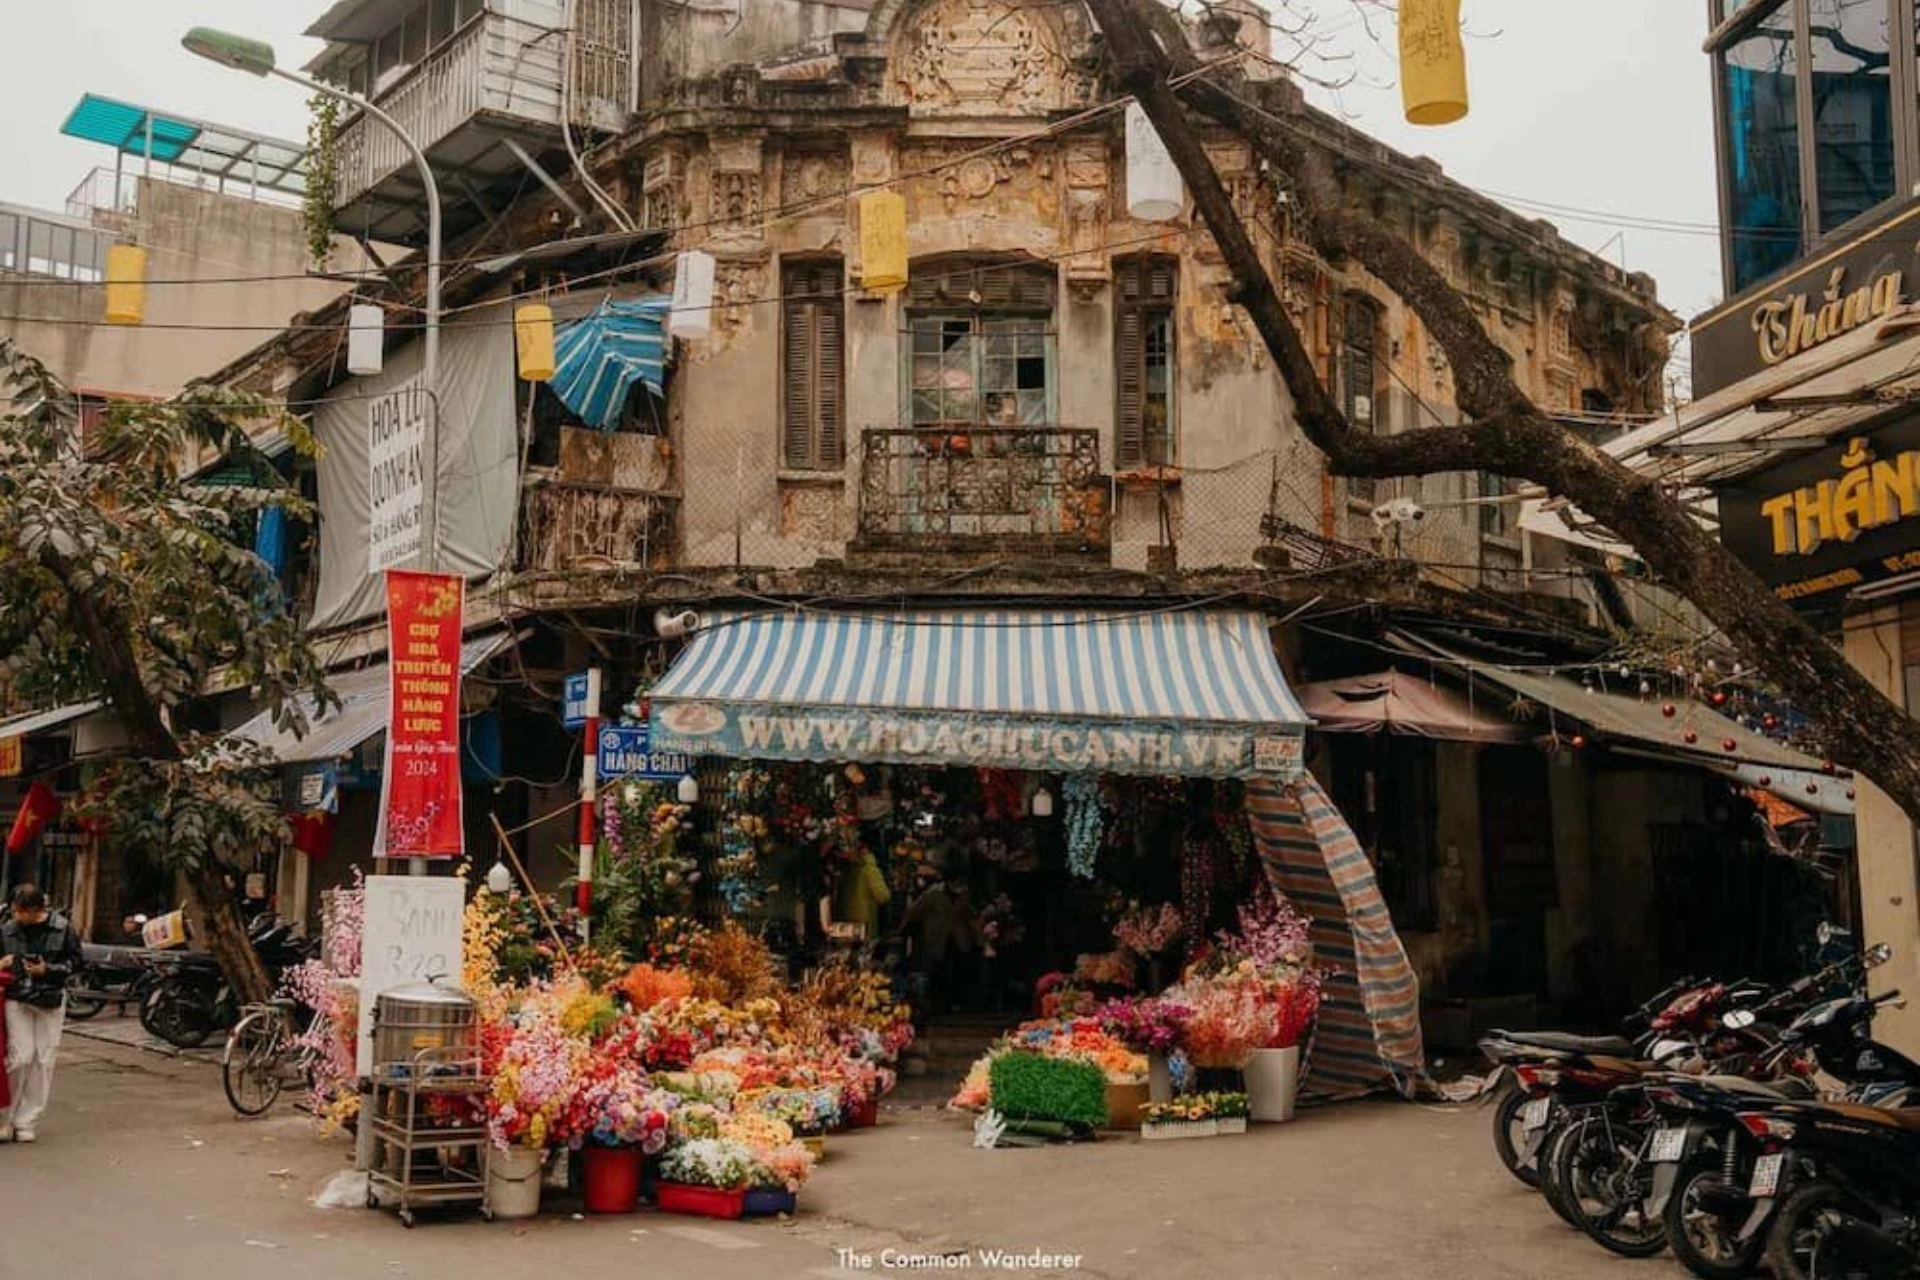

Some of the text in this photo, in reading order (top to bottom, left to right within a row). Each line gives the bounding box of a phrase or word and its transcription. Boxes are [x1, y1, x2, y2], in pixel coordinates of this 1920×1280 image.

[372, 393, 400, 447] HOA
[1761, 437, 1920, 554] THẮN
[408, 622, 440, 639] CHỢ
[408, 642, 439, 655] HOA
[400, 678, 450, 695] THỐNG
[405, 760, 437, 776] 2024
